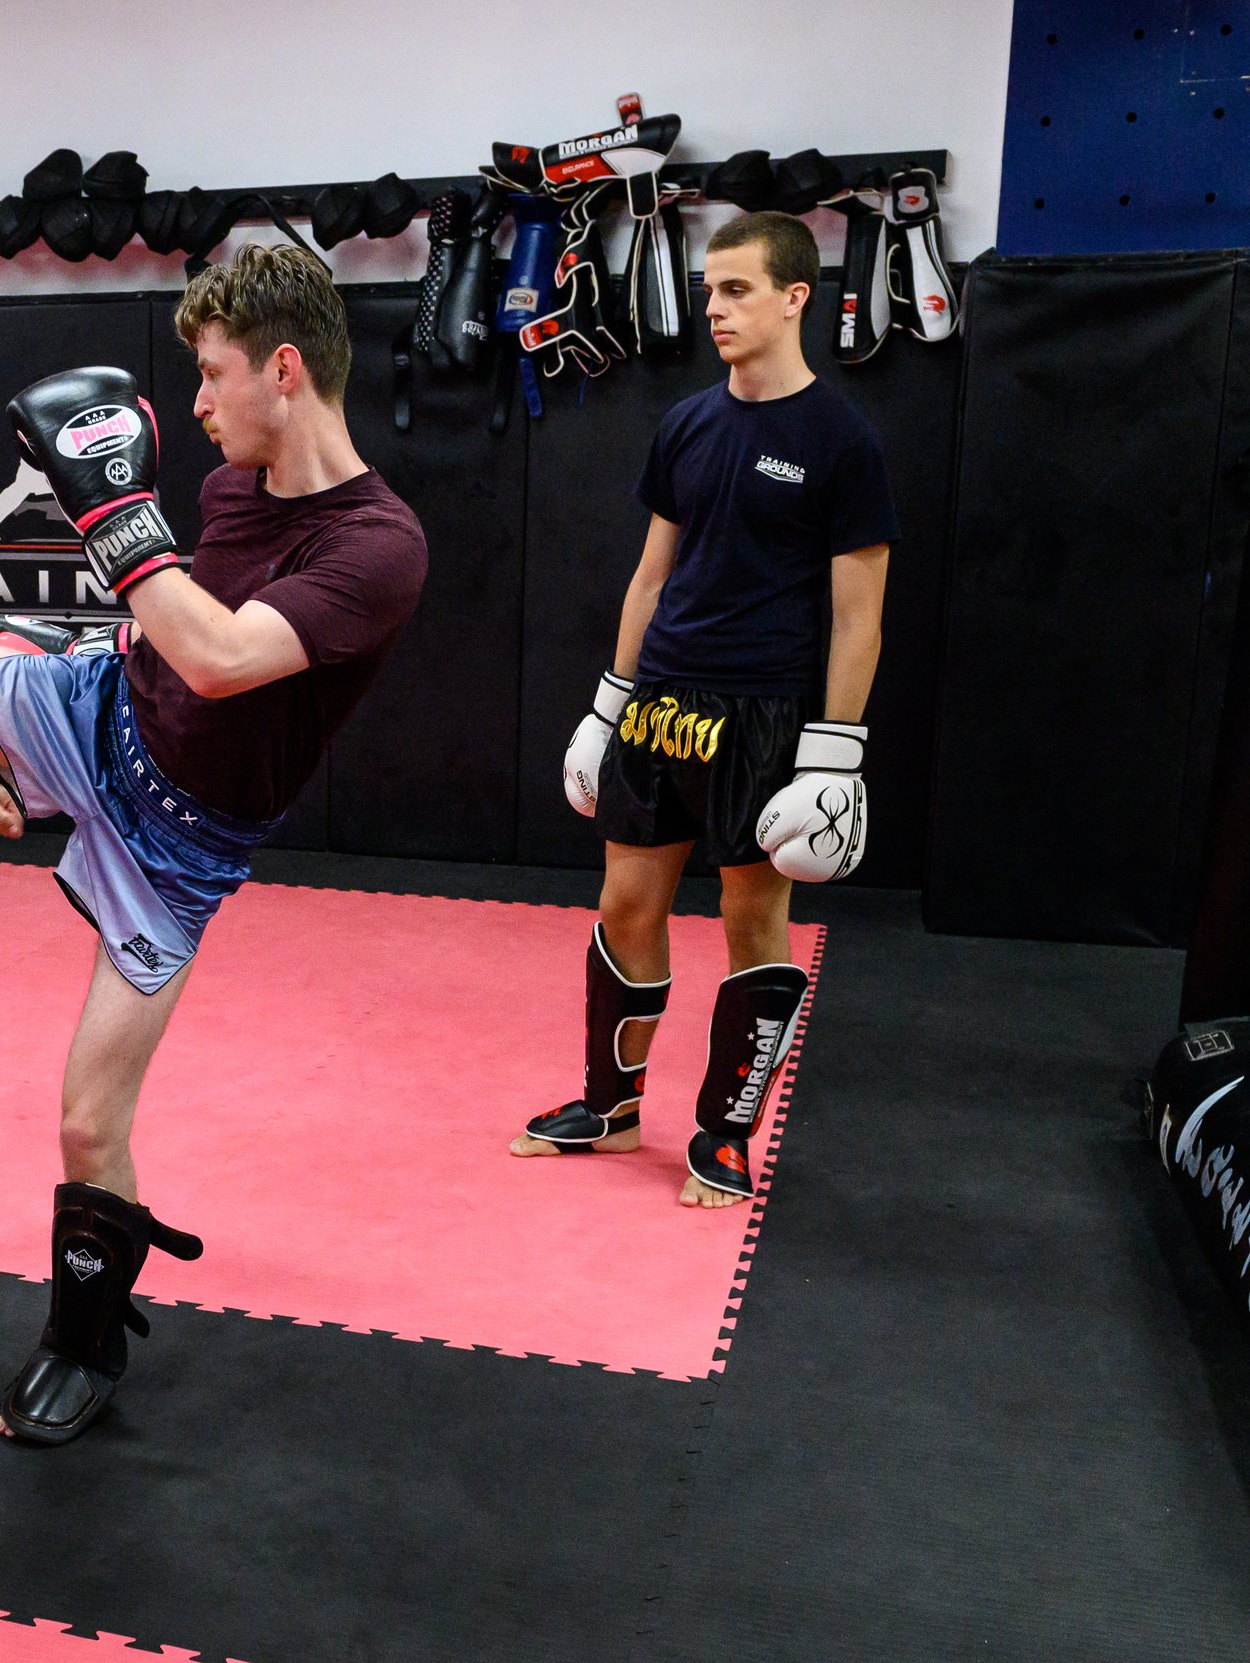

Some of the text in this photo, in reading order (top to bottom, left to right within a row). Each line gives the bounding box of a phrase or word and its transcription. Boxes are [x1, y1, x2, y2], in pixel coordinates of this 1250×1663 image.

[558, 124, 638, 155] MORGAN
[840, 293, 857, 348] SMAI
[70, 414, 133, 450] PUNCH
[756, 461, 804, 482] GROUNDS
[760, 454, 806, 474] TRAINING
[92, 508, 164, 572] PUNCH
[577, 770, 596, 802] STING
[758, 810, 781, 845] STING
[724, 1017, 780, 1123] MORGAN
[67, 1249, 102, 1272] PUNCH
